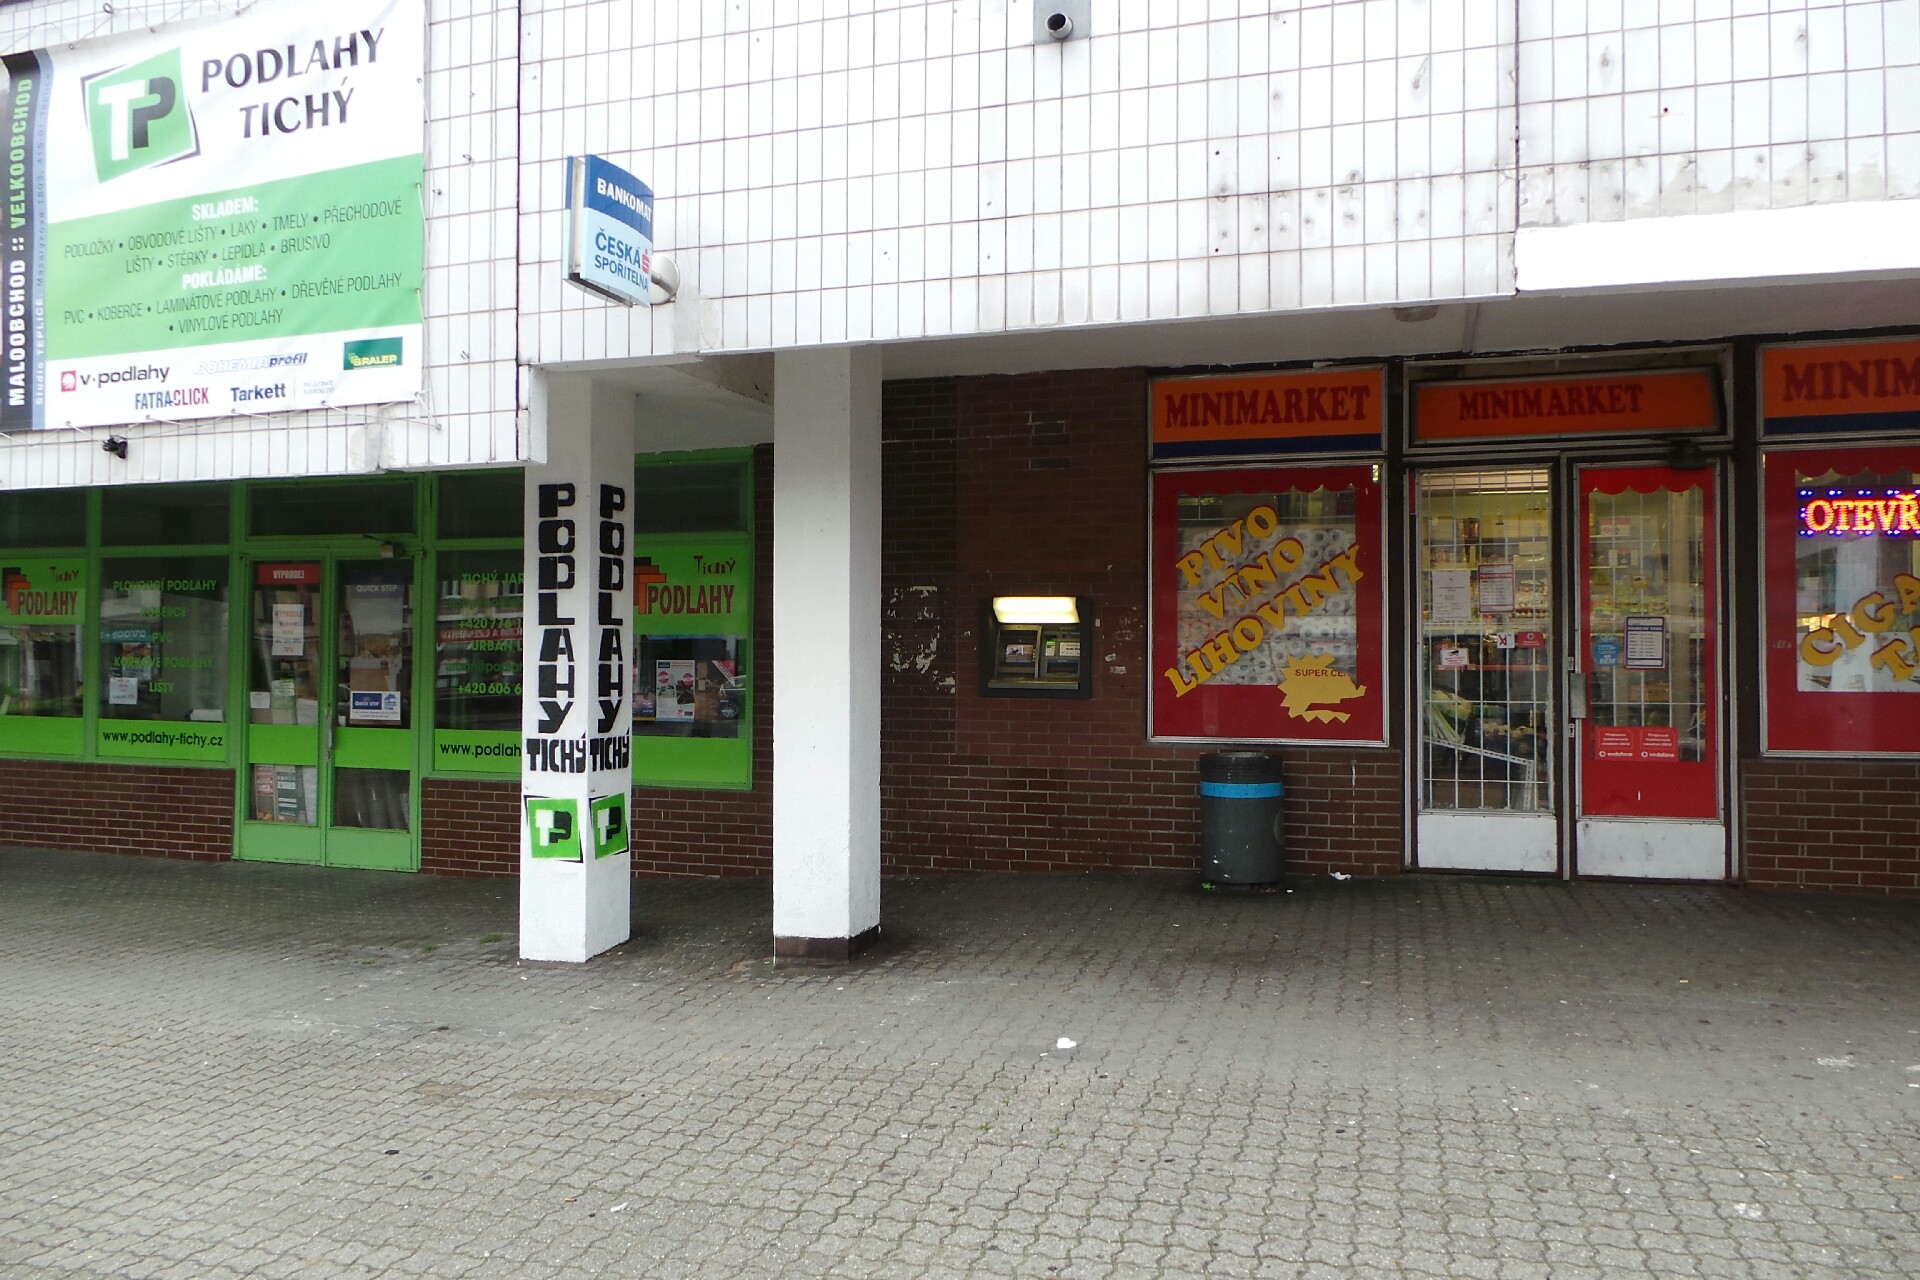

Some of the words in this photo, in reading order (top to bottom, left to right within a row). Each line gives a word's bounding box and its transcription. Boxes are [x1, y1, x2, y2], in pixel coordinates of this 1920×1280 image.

[201, 27, 385, 94] PODLAHY
[239, 76, 355, 139] TICHÝ
[9, 77, 34, 229] VELKOOBCHOD
[191, 195, 259, 221] SKLADEM:
[596, 177, 652, 222] BANKOMAT
[64, 237, 116, 259] PODLOŽKY
[127, 228, 185, 251] OBVODOVÉ
[188, 225, 218, 244] LIŠTY
[231, 219, 259, 237] LAKY
[273, 212, 309, 231] TMELY
[324, 196, 402, 225] PŘECHODOVÉ
[125, 254, 155, 274] LIŠTY
[222, 242, 266, 261] LEPIDLA
[281, 233, 331, 254] BRUSIVO
[182, 263, 267, 290] POKLÁDÁME:
[594, 255, 649, 293] SPOŘITELNA
[64, 309, 85, 325] PVC
[97, 302, 144, 321] KOBERCE
[157, 289, 223, 315] LAMINÁTOVÉ
[226, 286, 277, 307] PODLAHY
[292, 275, 344, 299] DŘEVĚNÉ
[347, 272, 403, 293] PODLAHY
[8, 259, 27, 407] MALOOBCHOD
[179, 310, 229, 334] VINYLOVÉ
[232, 308, 284, 328] PODLAHY
[230, 382, 286, 402] Tarkett
[1164, 384, 1371, 429] MINIMARKET
[1458, 383, 1644, 421] MINIMARKET
[1175, 504, 1279, 589] PIVO
[167, 579, 217, 591] PODLAHY
[380, 584, 397, 592] STEP
[462, 570, 498, 585] TICHÝ
[1196, 536, 1305, 619] VÍNO
[18, 591, 78, 615] PODLAHY
[538, 483, 575, 734] PODLAHY
[598, 484, 626, 734] PODLAHY
[647, 584, 735, 615] PODLAHY
[459, 617, 487, 629] +420
[1164, 544, 1364, 698] LIHOVINY
[471, 640, 513, 651] URBAN
[457, 682, 486, 694] +420
[488, 683, 511, 695] 606
[1295, 668, 1328, 677] SUPER
[102, 731, 224, 747] www.podlahy-tichy.cz
[525, 730, 587, 773] TICHÝ
[589, 730, 630, 773] TICHÝ
